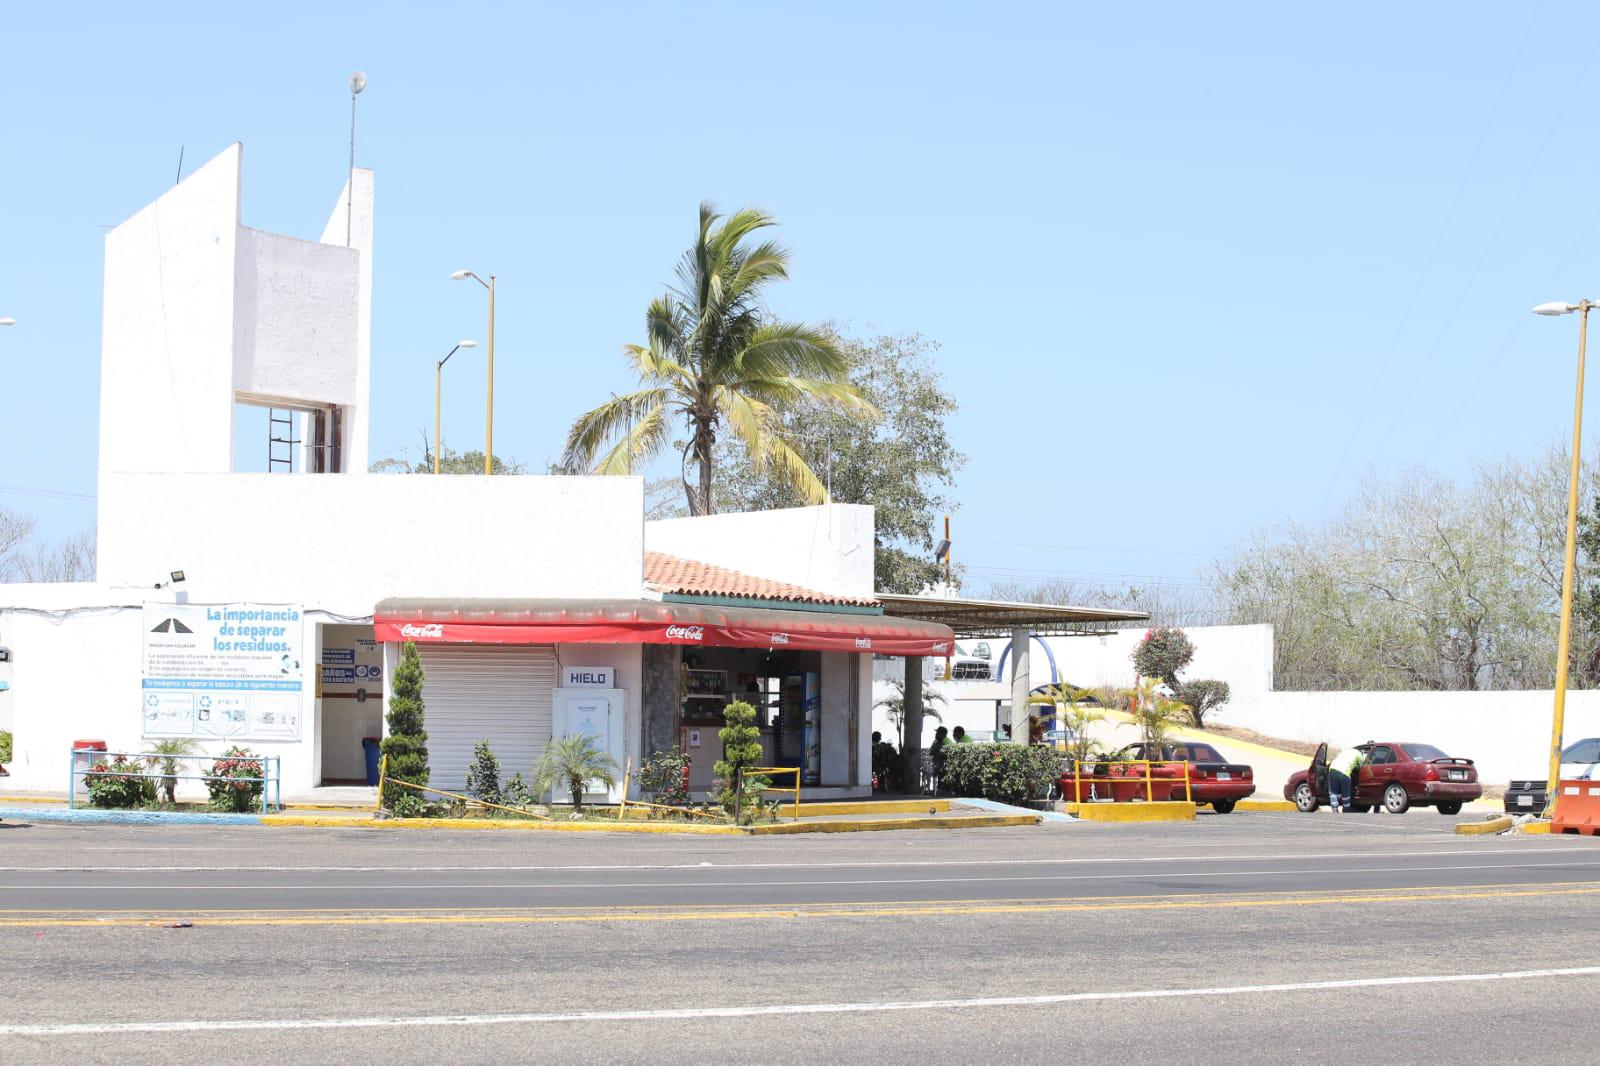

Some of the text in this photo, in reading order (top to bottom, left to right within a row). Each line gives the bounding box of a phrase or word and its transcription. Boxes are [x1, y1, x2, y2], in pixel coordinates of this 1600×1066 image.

[207, 607, 299, 624] La importancia
[219, 622, 286, 639] de separar
[213, 637, 291, 652] los residuos.
[570, 673, 606, 684] HIELO
